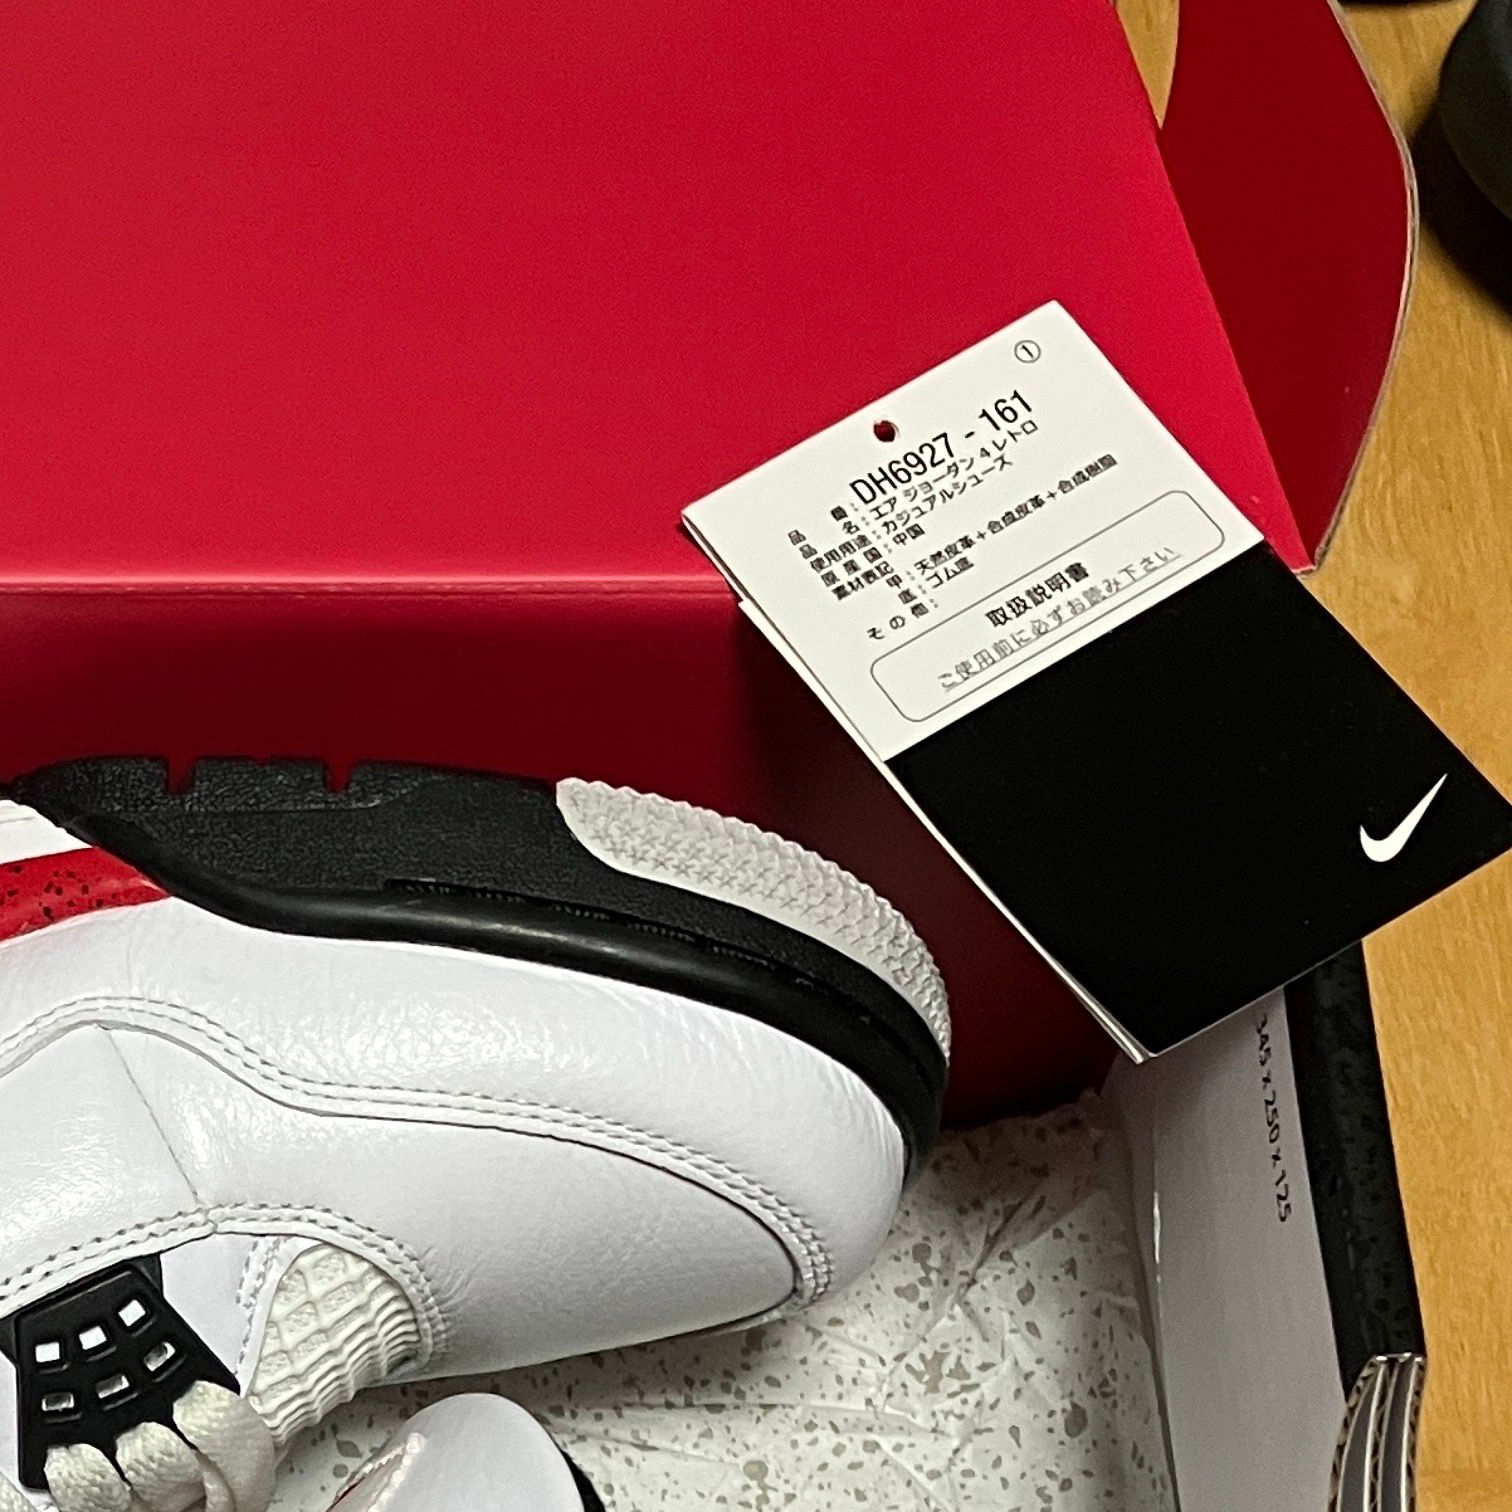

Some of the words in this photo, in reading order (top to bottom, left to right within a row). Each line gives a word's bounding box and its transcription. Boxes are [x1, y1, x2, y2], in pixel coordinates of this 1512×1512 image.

[849, 432, 954, 505] DH6927
[979, 390, 1032, 431] 161
[985, 563, 1089, 627] 取扱説明書
